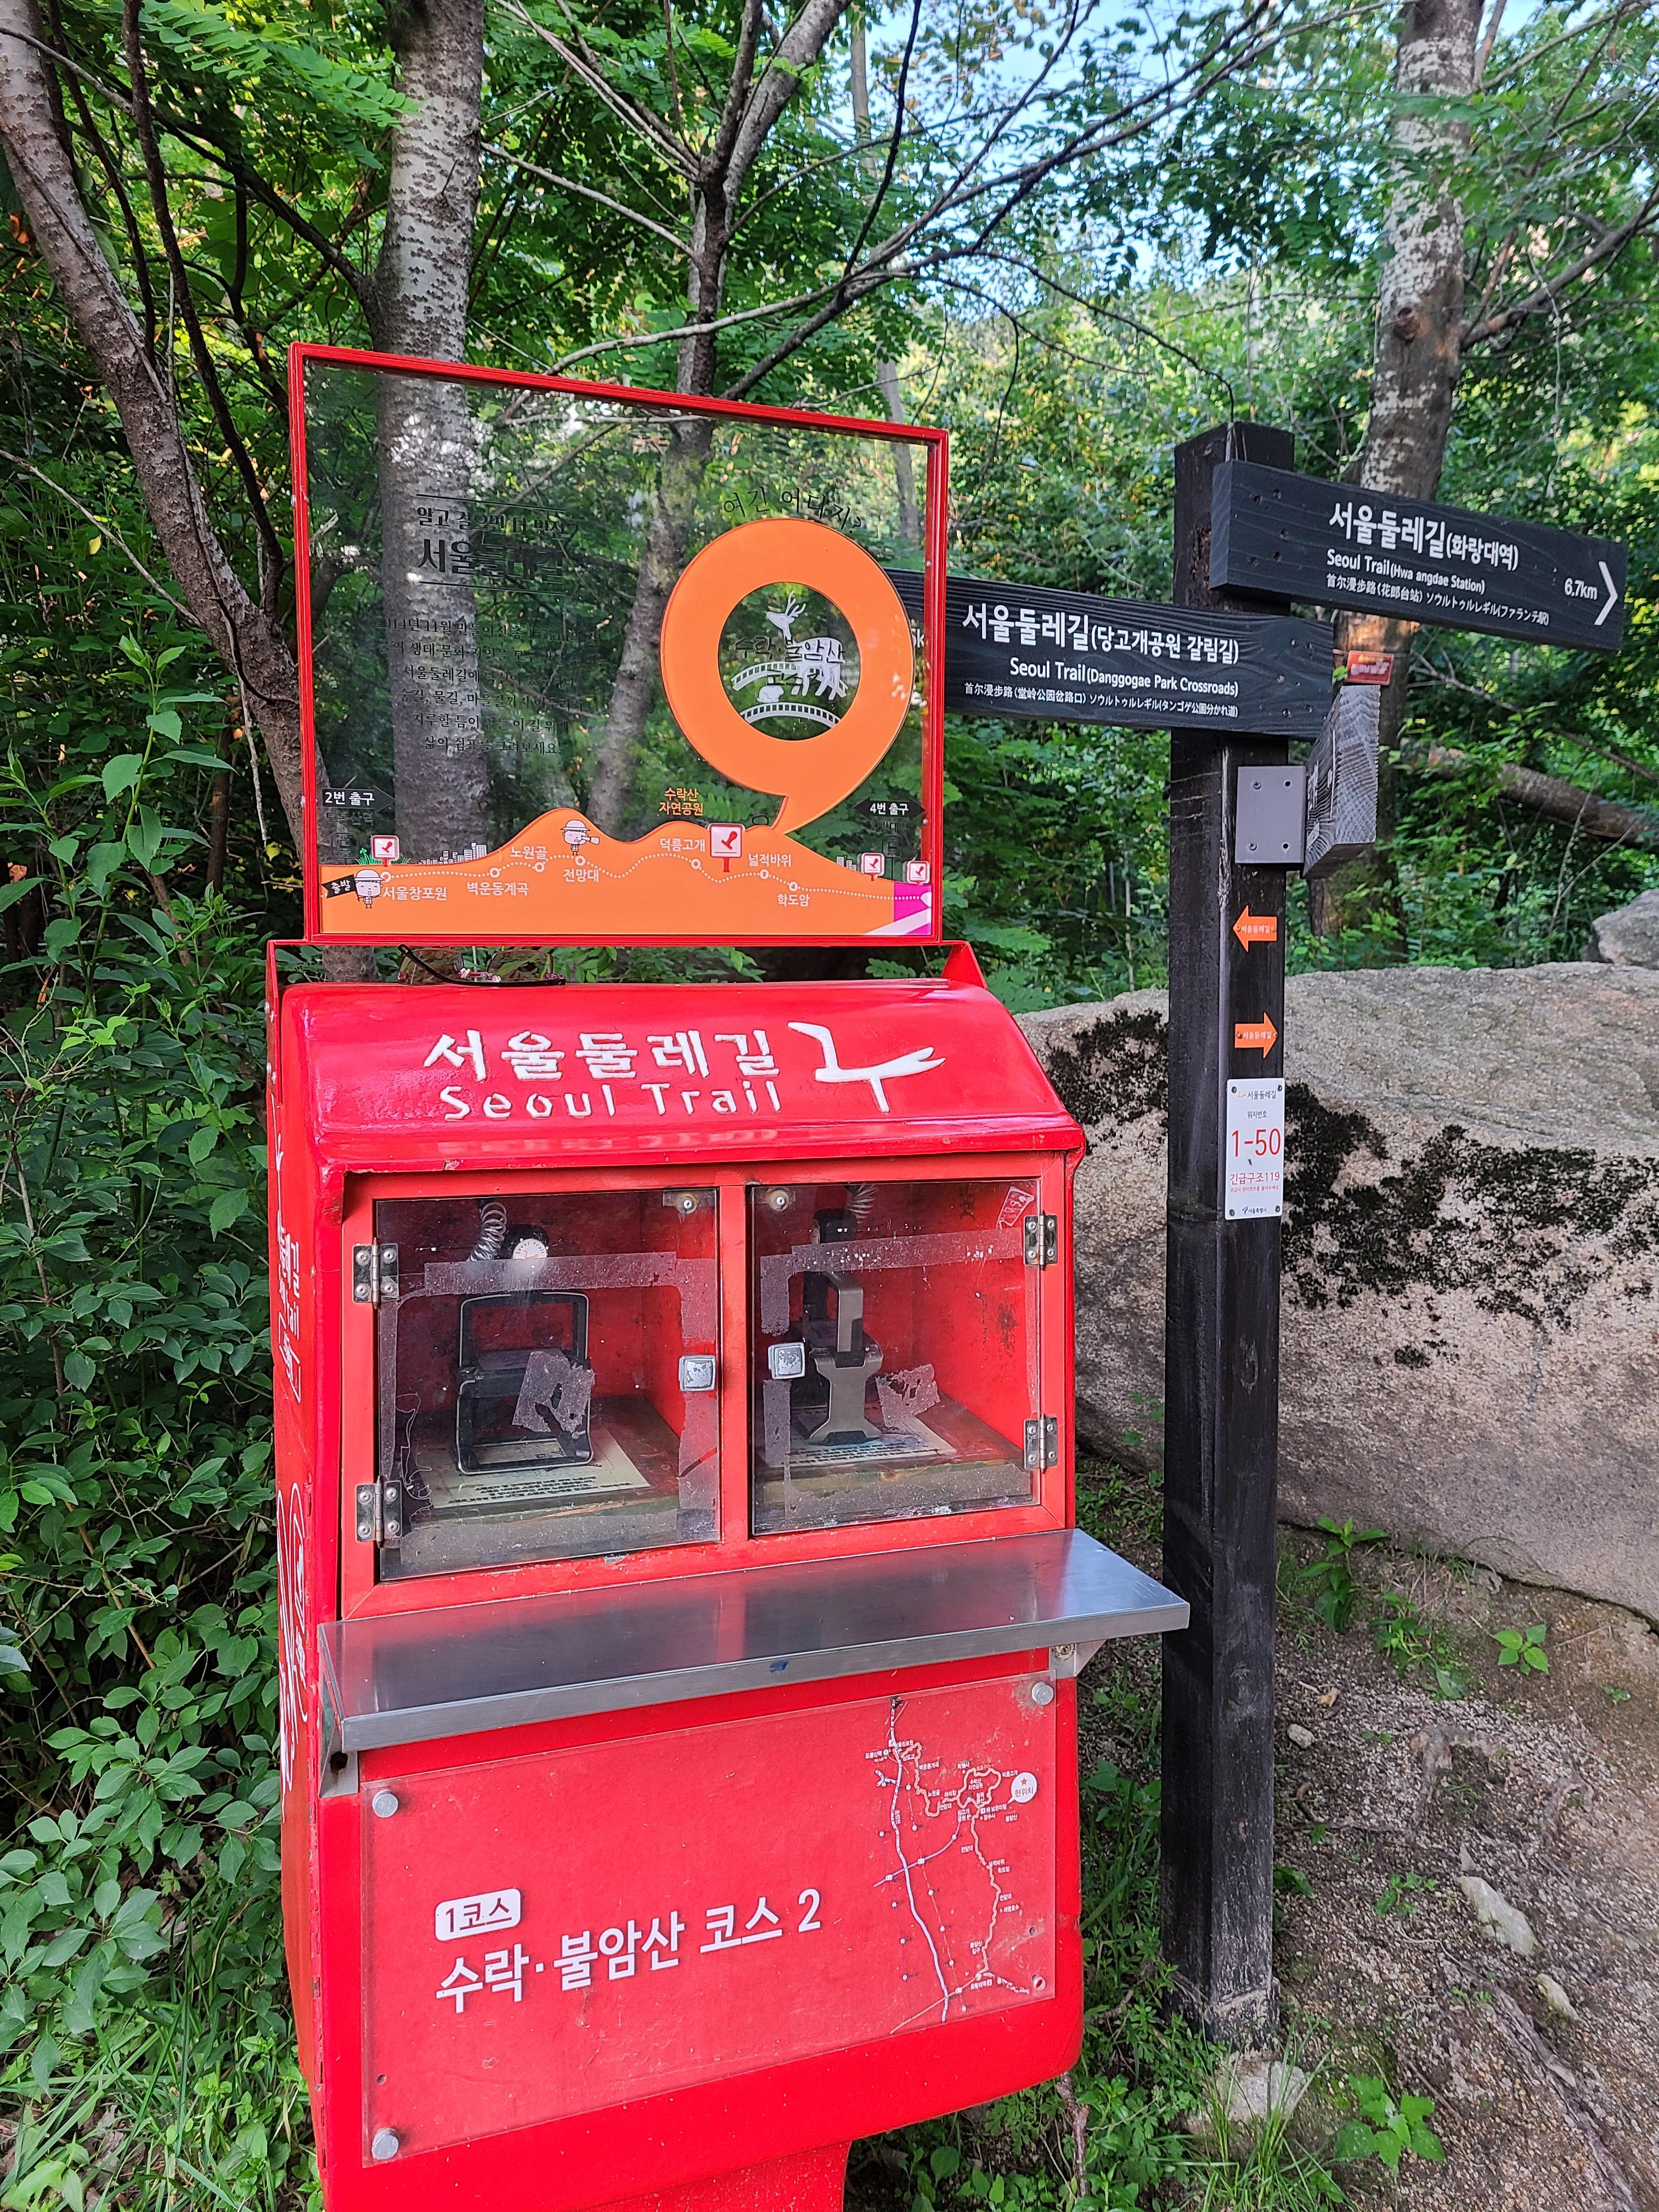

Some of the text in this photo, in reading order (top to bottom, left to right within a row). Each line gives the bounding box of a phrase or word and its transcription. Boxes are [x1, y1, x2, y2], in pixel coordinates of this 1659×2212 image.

[417, 507, 450, 527] 알고
[724, 487, 861, 534] 여긴 어디지?
[1329, 503, 1518, 571] 서울둘레길(화랑대역)
[417, 538, 563, 584] 서울둘레길
[1327, 549, 1360, 570] Seoul
[1416, 571, 1448, 587] angdae
[1451, 574, 1485, 595] Station)
[1565, 578, 1598, 600] 6.7km
[962, 602, 1239, 665] 서울둘레길(당고개공원 갈림길)
[1010, 657, 1239, 698] Seoul Trail(Danggogae Park Crossroads)
[435, 690, 463, 708] 물길,
[413, 713, 452, 729] 지루할
[455, 714, 479, 730] 틈이
[325, 791, 375, 805] 2번 출구
[664, 788, 699, 801] 수락산
[658, 802, 704, 816] 자연공원
[870, 803, 909, 816] 4번 출구
[510, 845, 548, 860] 노원골
[659, 838, 706, 853] 덕릉고개
[748, 853, 792, 868] 넓적바위
[563, 868, 600, 883] 전망대
[331, 879, 351, 893] 출발
[383, 887, 448, 901] 서울창포원
[466, 881, 529, 897] 벽운동계곡
[777, 893, 810, 907] 학도암
[422, 1029, 779, 1083] 서울둘레길
[439, 1080, 782, 1122] Seoul Trail
[1248, 1090, 1277, 1100] 서울둘레길
[1247, 1110, 1268, 1119] 위치번호
[1232, 1127, 1281, 1157] 1-50
[1229, 1171, 1280, 1185] 긴급구조119
[1014, 1786, 1034, 1797] 현위치
[445, 1897, 512, 1933] 1코스
[436, 1888, 821, 2014] 수락·불암산 코스 2
